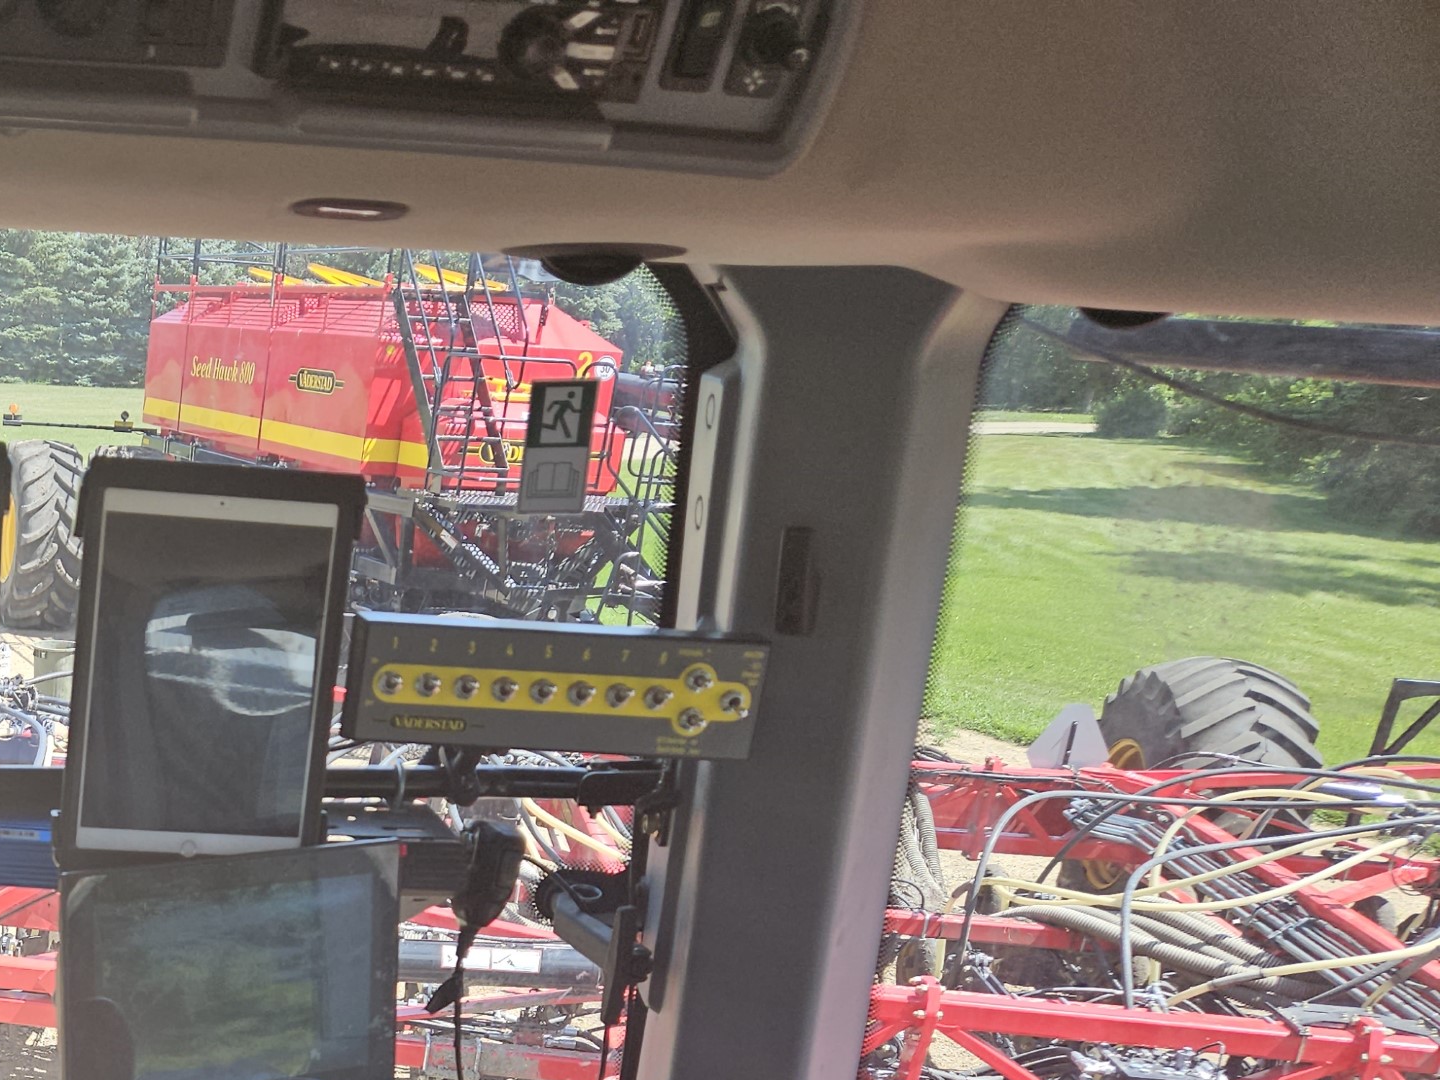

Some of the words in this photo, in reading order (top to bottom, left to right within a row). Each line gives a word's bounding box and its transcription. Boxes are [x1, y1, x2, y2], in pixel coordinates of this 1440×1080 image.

[190, 355, 212, 379] Seed
[213, 357, 239, 383] Hawk
[239, 361, 256, 385] 800
[298, 370, 333, 391] VÄDERSTAD
[392, 636, 399, 649] 1
[429, 638, 438, 652] 2
[468, 640, 477, 654] 3
[544, 644, 554, 658] 5
[621, 649, 630, 662] 7
